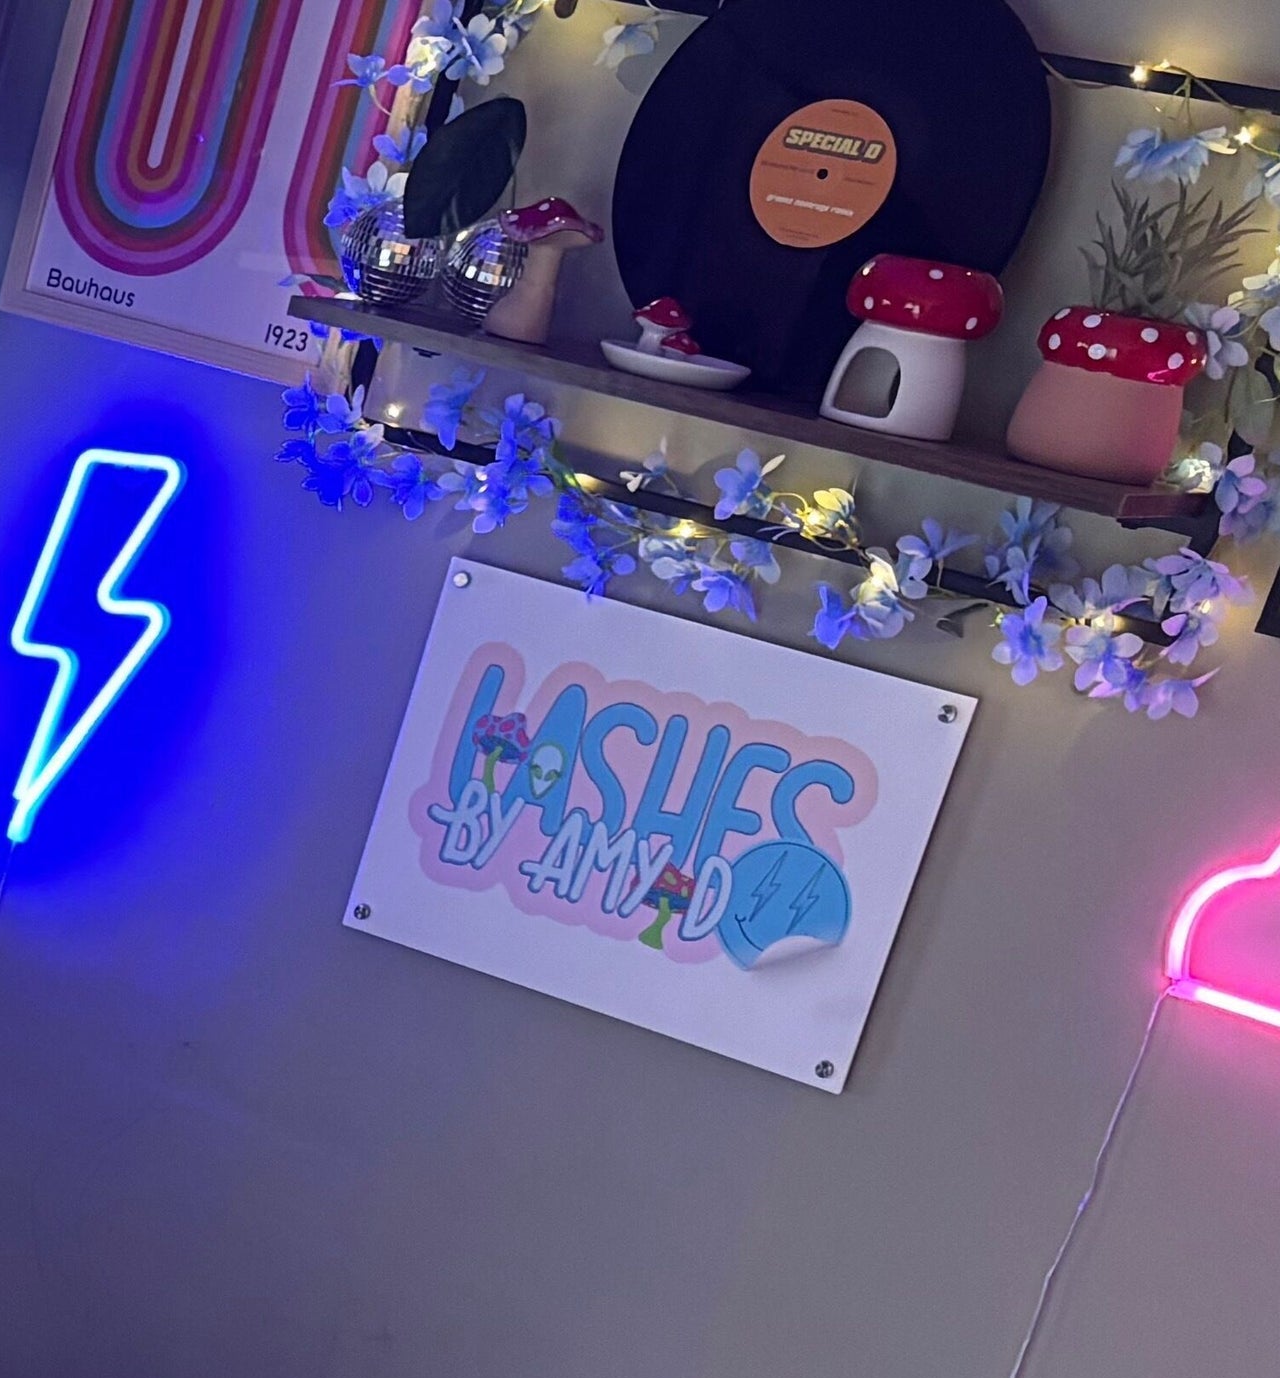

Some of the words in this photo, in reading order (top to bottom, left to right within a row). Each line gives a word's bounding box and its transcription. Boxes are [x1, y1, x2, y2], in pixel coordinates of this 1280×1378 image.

[785, 128, 863, 156] SPECIAL
[864, 142, 883, 160] D
[45, 267, 136, 308] Bauhaus
[263, 323, 309, 352] 1923
[448, 663, 855, 870] LASHES
[427, 779, 526, 871] BY
[520, 806, 674, 919] AMY
[678, 855, 734, 942] D
